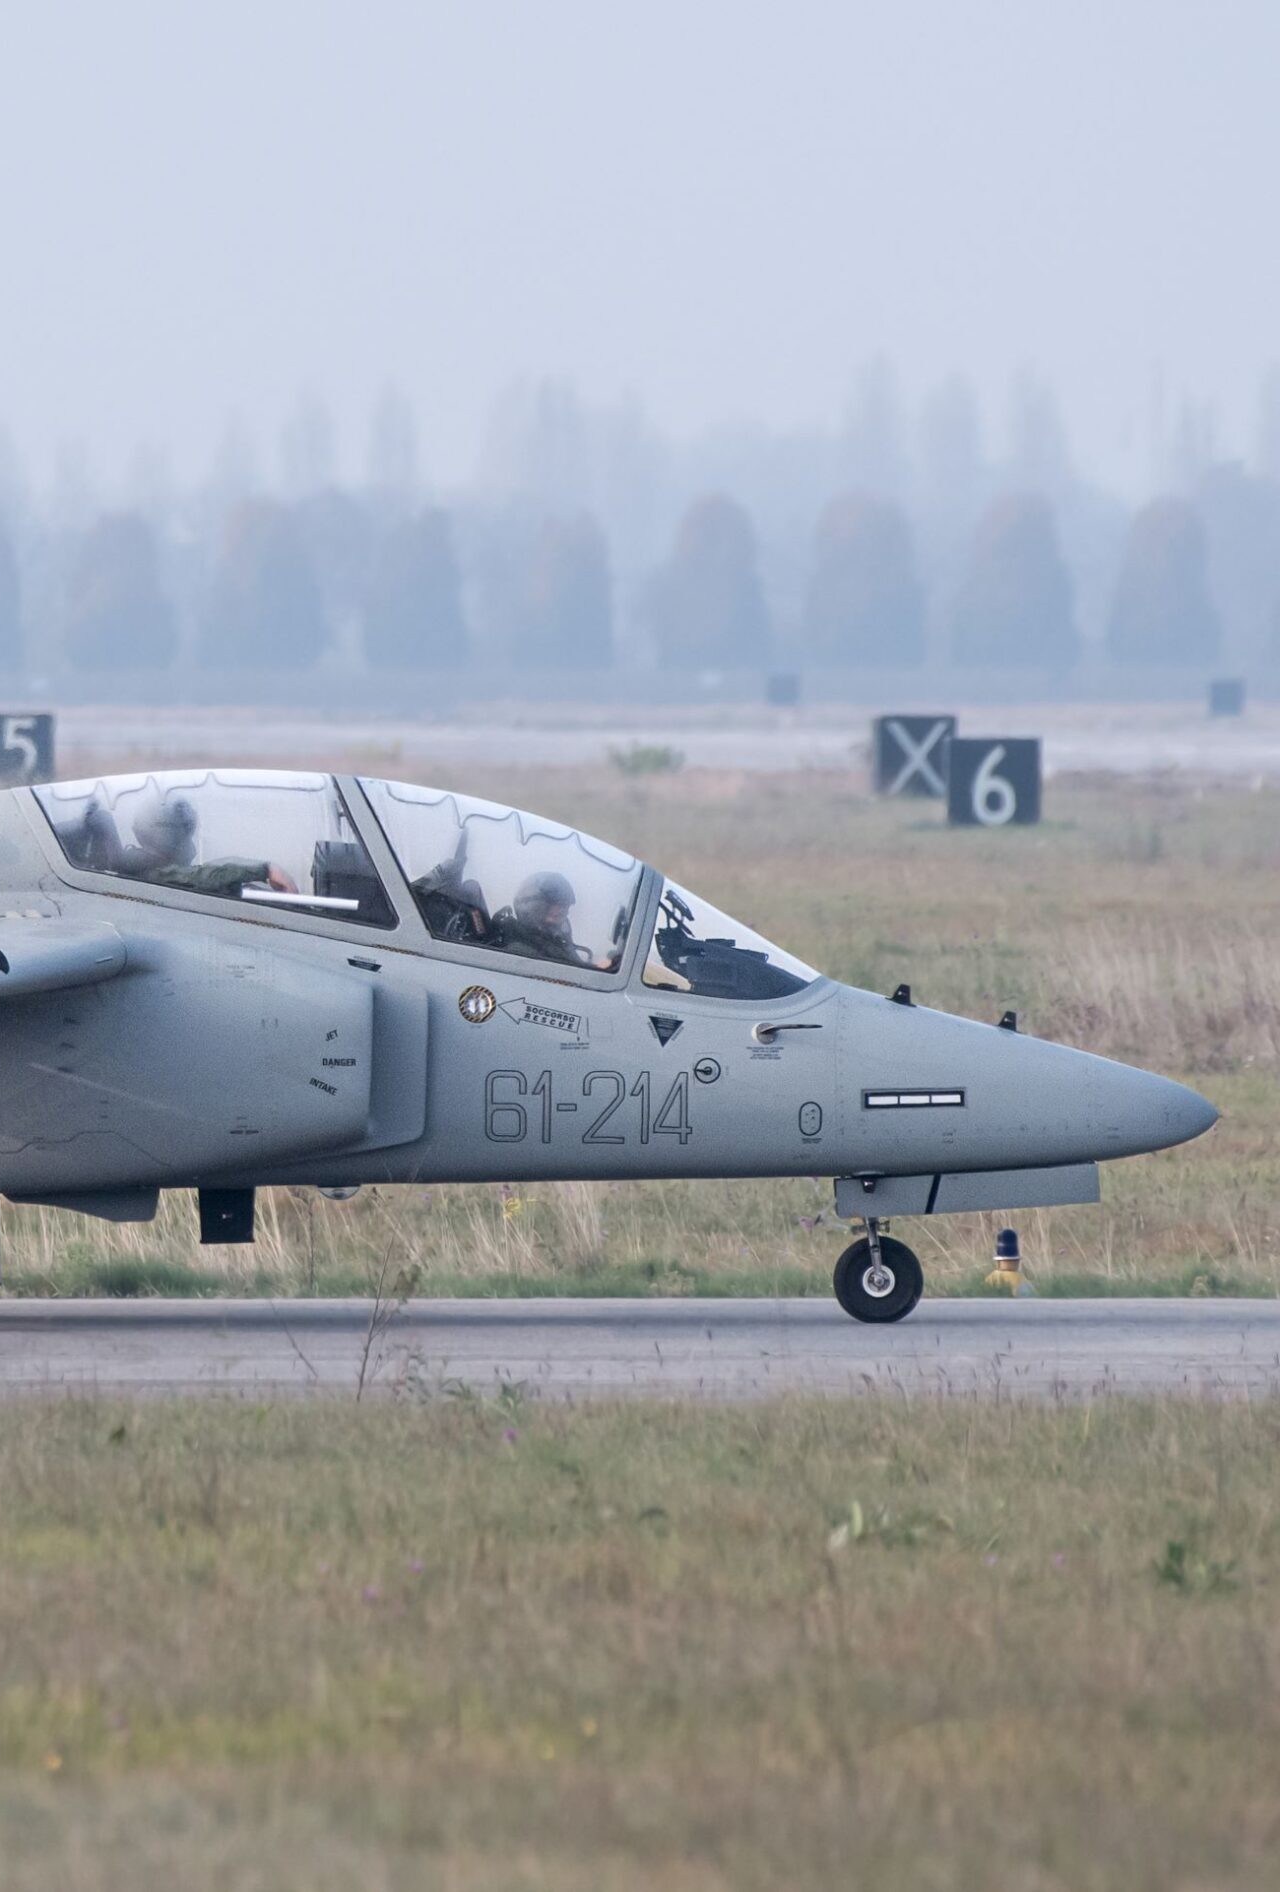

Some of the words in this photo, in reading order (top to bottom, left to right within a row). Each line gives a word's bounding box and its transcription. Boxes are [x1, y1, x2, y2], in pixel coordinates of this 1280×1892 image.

[3, 717, 38, 777] 5
[886, 720, 949, 794] X
[972, 744, 1016, 826] 6
[524, 1012, 574, 1030] RESCUE
[526, 1005, 575, 1022] SOCCORSO
[325, 1029, 338, 1042] JET
[322, 1058, 357, 1067] DANGER
[309, 1077, 338, 1096] INTAKE
[484, 1069, 693, 1145] 61-214
